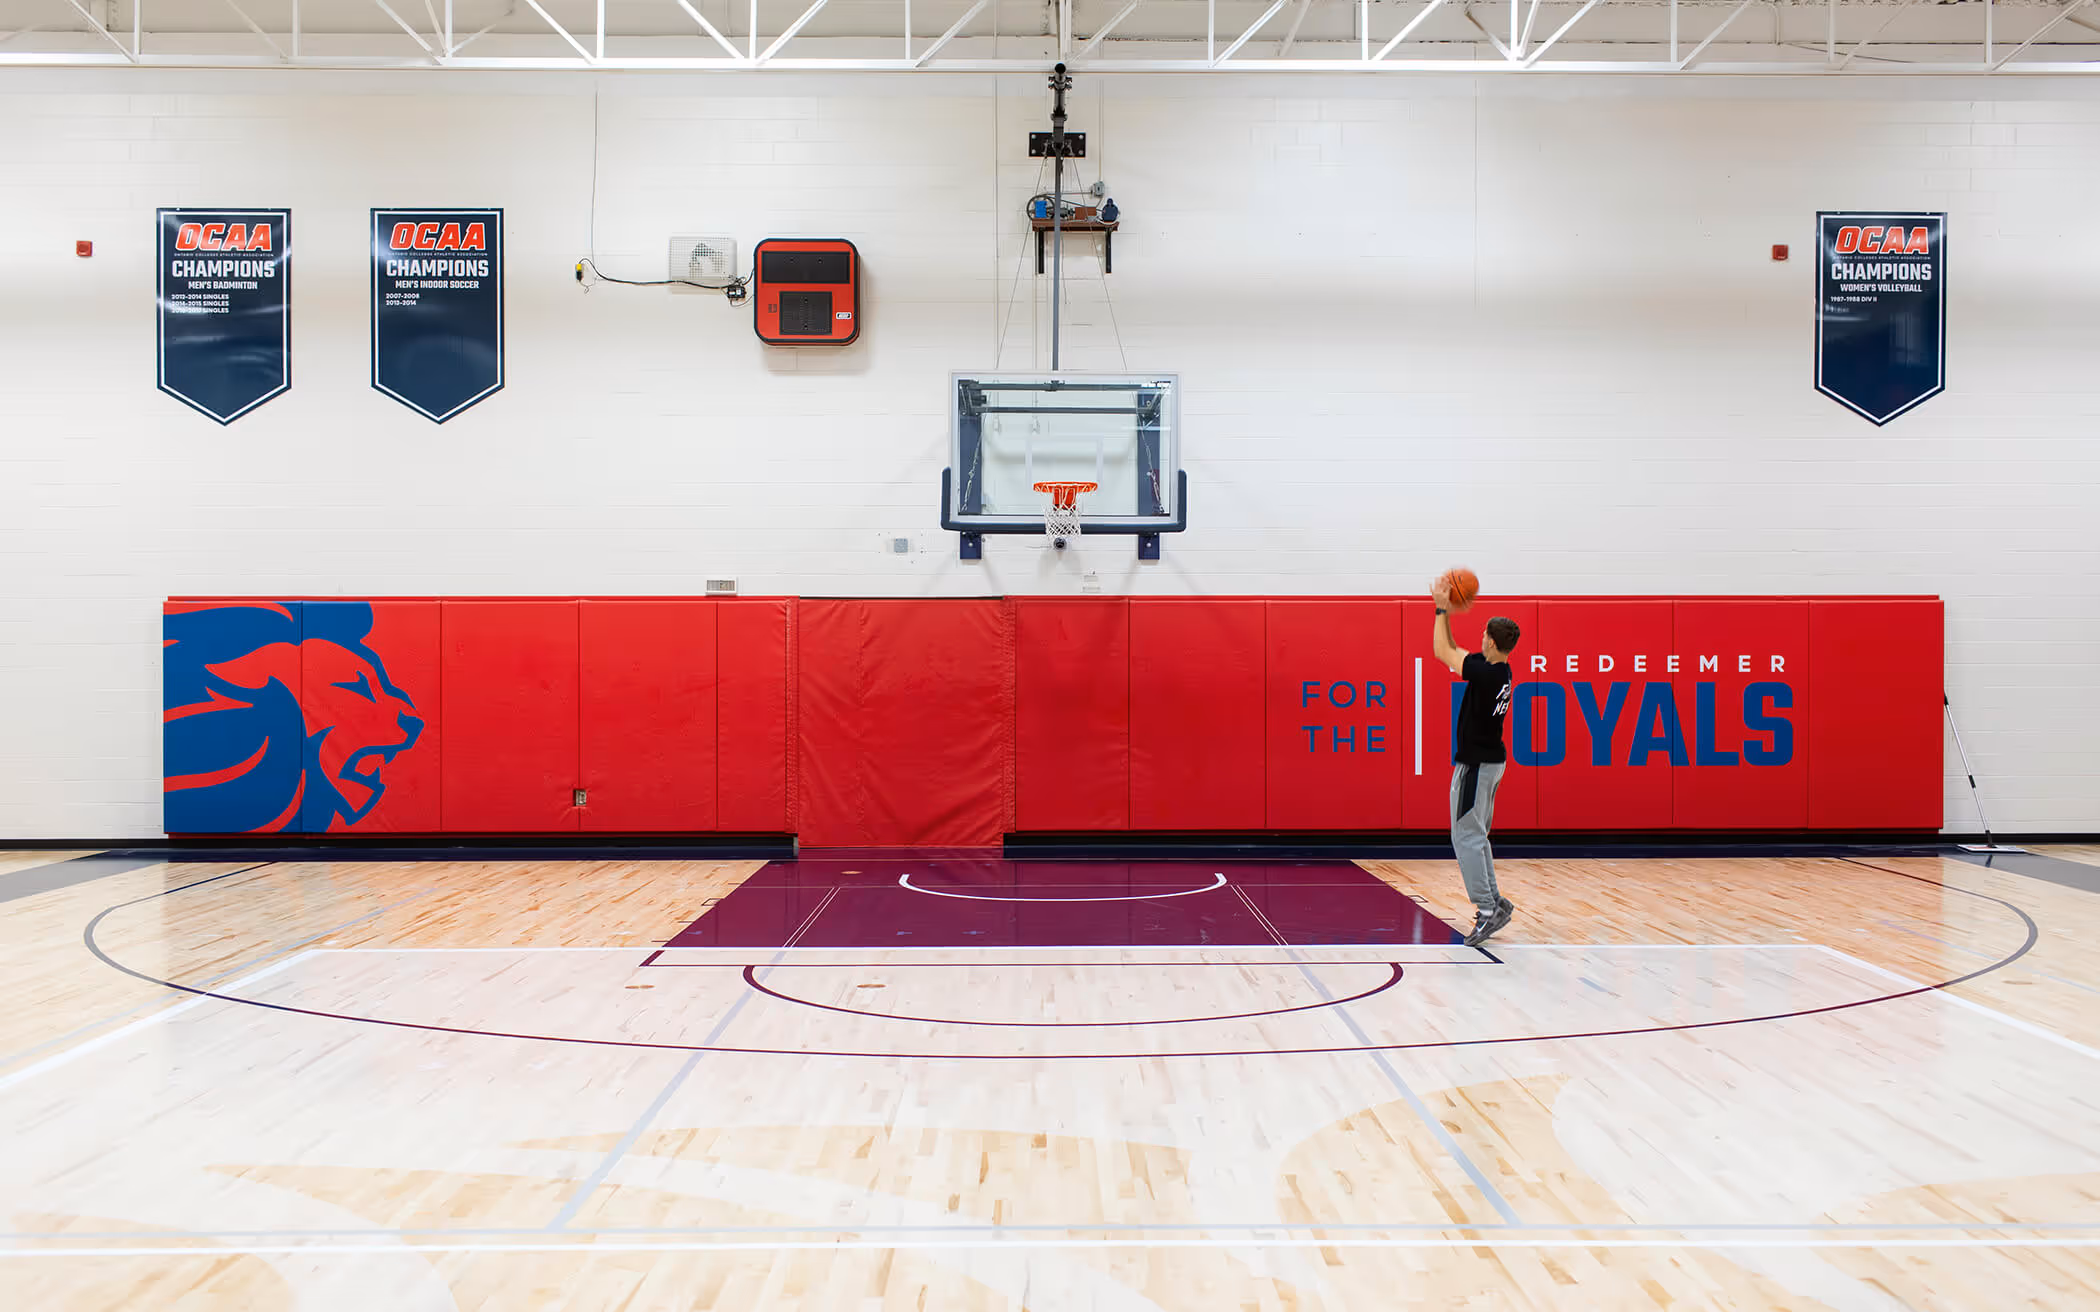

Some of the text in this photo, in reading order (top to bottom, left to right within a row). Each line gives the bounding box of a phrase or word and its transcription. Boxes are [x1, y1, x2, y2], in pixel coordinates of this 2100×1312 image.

[175, 223, 273, 251] OCAA
[389, 222, 486, 250] OCAA
[1835, 226, 1930, 254] OCAA
[172, 260, 275, 278] CHAMPIONS
[386, 259, 489, 277] CHAMPIONS
[1831, 263, 1932, 281] CHAMPIONS
[188, 281, 258, 289] MEN'S BADMINTON
[395, 280, 479, 289] MEN'S INDOOR SOCCER
[1840, 284, 1922, 292] WOMEN'S VOLLEYBALL
[1530, 654, 1785, 673] REDEEMER
[1302, 680, 1386, 708] FOR
[1301, 725, 1385, 753] THE
